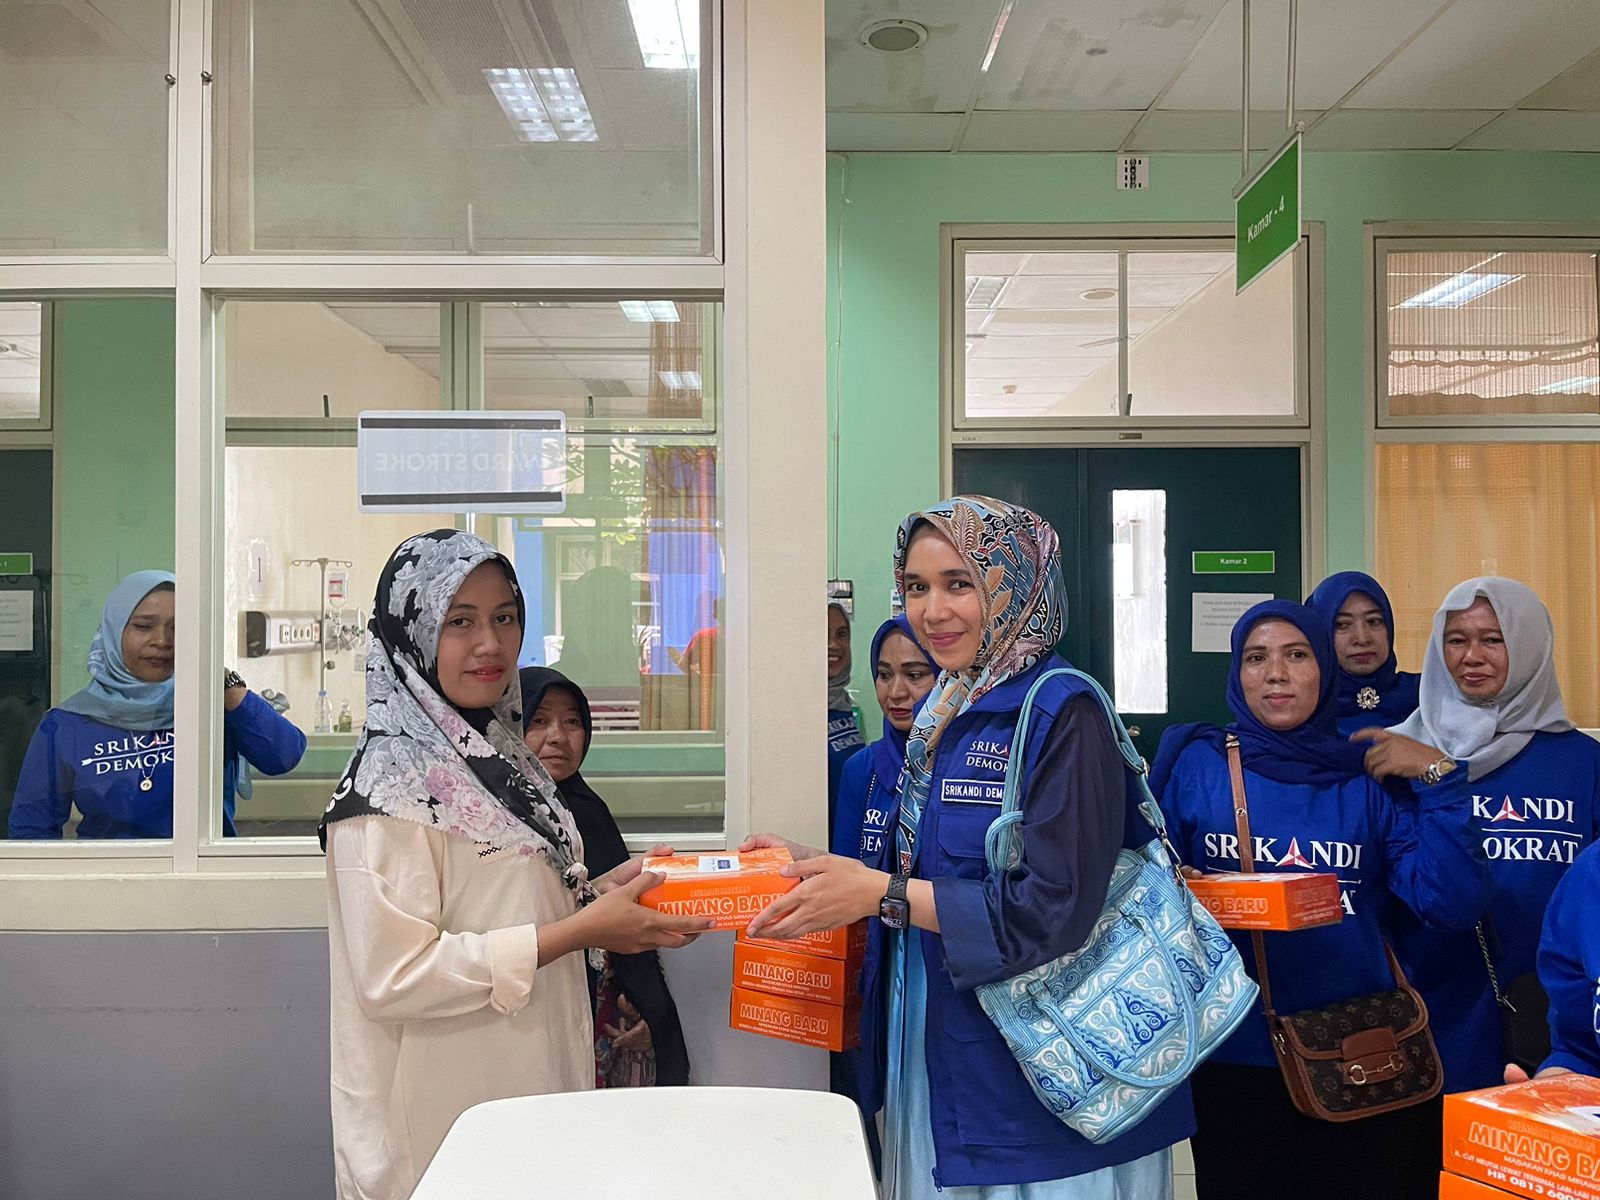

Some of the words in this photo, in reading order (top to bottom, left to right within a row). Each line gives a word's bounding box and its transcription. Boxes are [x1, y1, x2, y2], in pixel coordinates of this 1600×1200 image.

[1247, 209, 1273, 243] Kamar
[1278, 195, 1285, 213] 4
[96, 750, 175, 775] DEMOK
[945, 784, 982, 798] SRIKANDI
[985, 787, 1003, 799] DEM
[1204, 833, 1363, 870] SRKANDI
[658, 897, 735, 917] MINANG
[737, 893, 786, 913] BAR
[1223, 897, 1269, 915] BARU
[800, 930, 833, 943] ARU
[743, 961, 795, 983] MINANG
[796, 970, 832, 990] BARU
[740, 1003, 792, 1027] MINANG
[793, 1014, 829, 1036] BARU
[1468, 1121, 1571, 1171] MINANG
[1509, 1176, 1544, 1195] 0813
